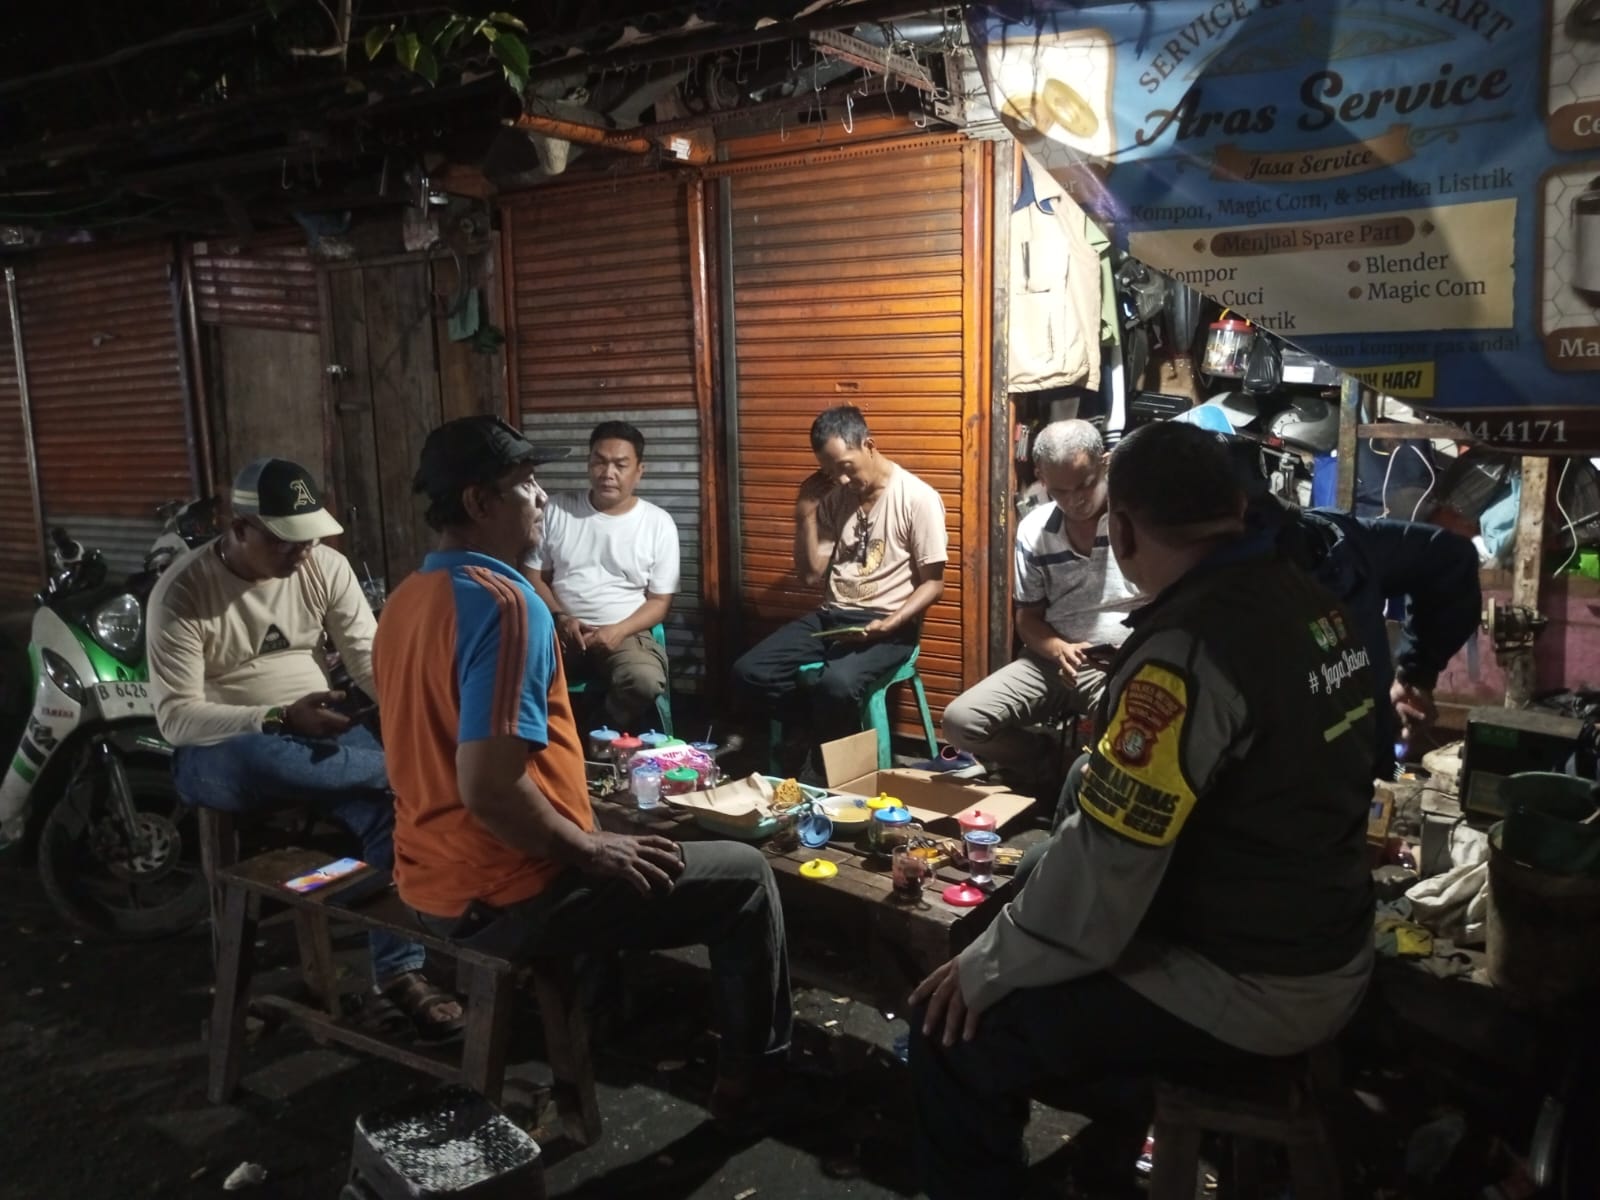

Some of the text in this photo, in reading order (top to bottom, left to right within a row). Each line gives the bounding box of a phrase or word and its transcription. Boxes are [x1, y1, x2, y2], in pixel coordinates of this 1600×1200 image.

[1139, 0, 1251, 93] SERVICE
[1135, 63, 1512, 146] Aras Service
[1244, 148, 1373, 180] Jasa Service
[1217, 195, 1273, 218] Magic
[1333, 187, 1350, 204] &
[1355, 178, 1432, 202] Setrika
[1438, 167, 1513, 194] Listrik
[1222, 222, 1403, 254] Menjual Spare Part
[1367, 252, 1449, 274] Blender
[1222, 287, 1264, 306] Cuci
[1368, 280, 1430, 303] Magic
[1382, 370, 1423, 390] HARI
[290, 480, 316, 510] A
[97, 683, 148, 700] B 6426
